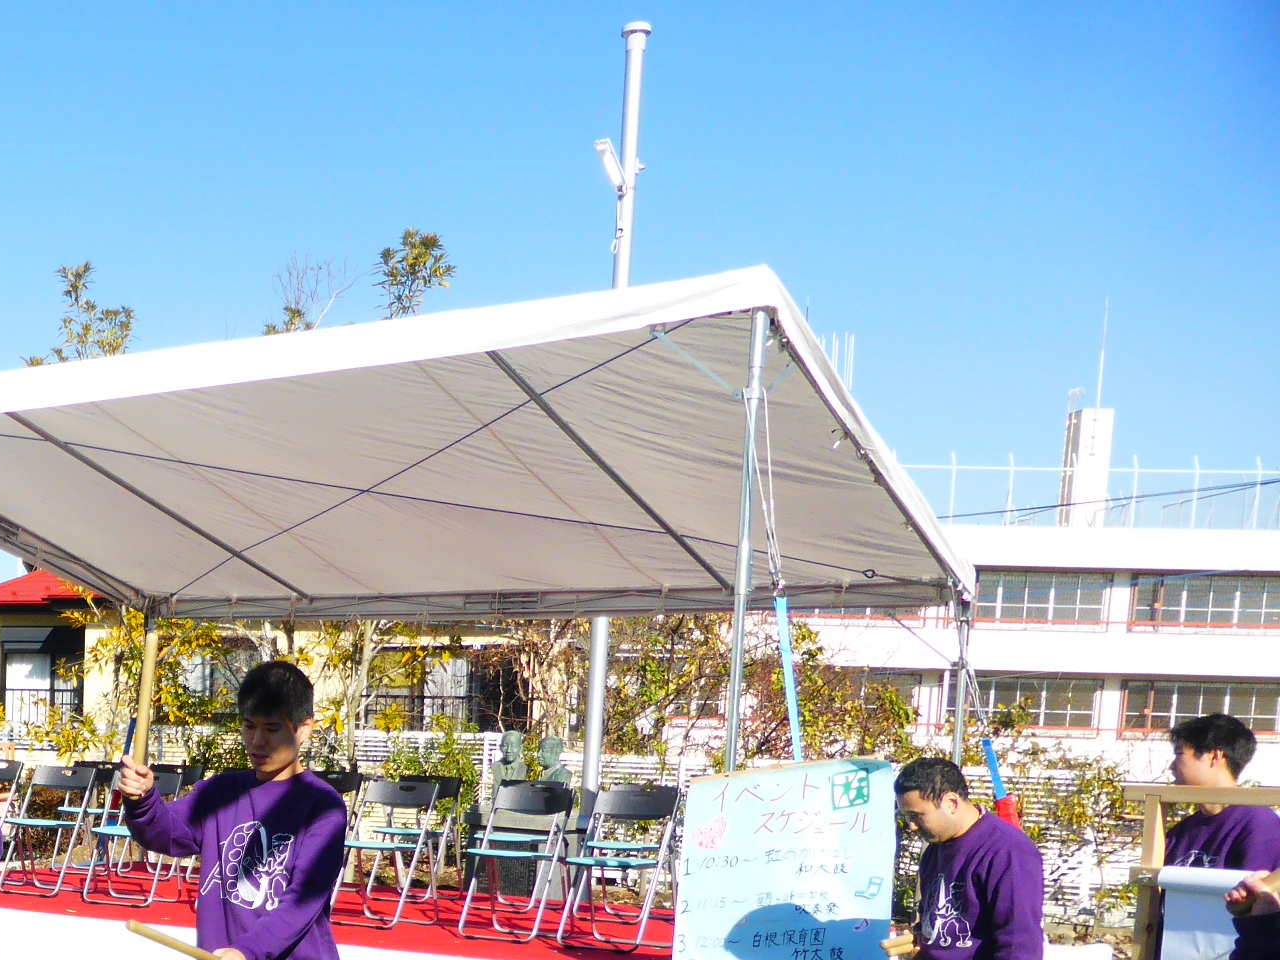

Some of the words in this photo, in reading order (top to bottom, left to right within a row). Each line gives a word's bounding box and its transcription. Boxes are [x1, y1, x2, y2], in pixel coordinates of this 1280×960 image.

[712, 773, 820, 813] イベント
[754, 809, 873, 835] スケジュール
[752, 927, 827, 948] 白根保育園
